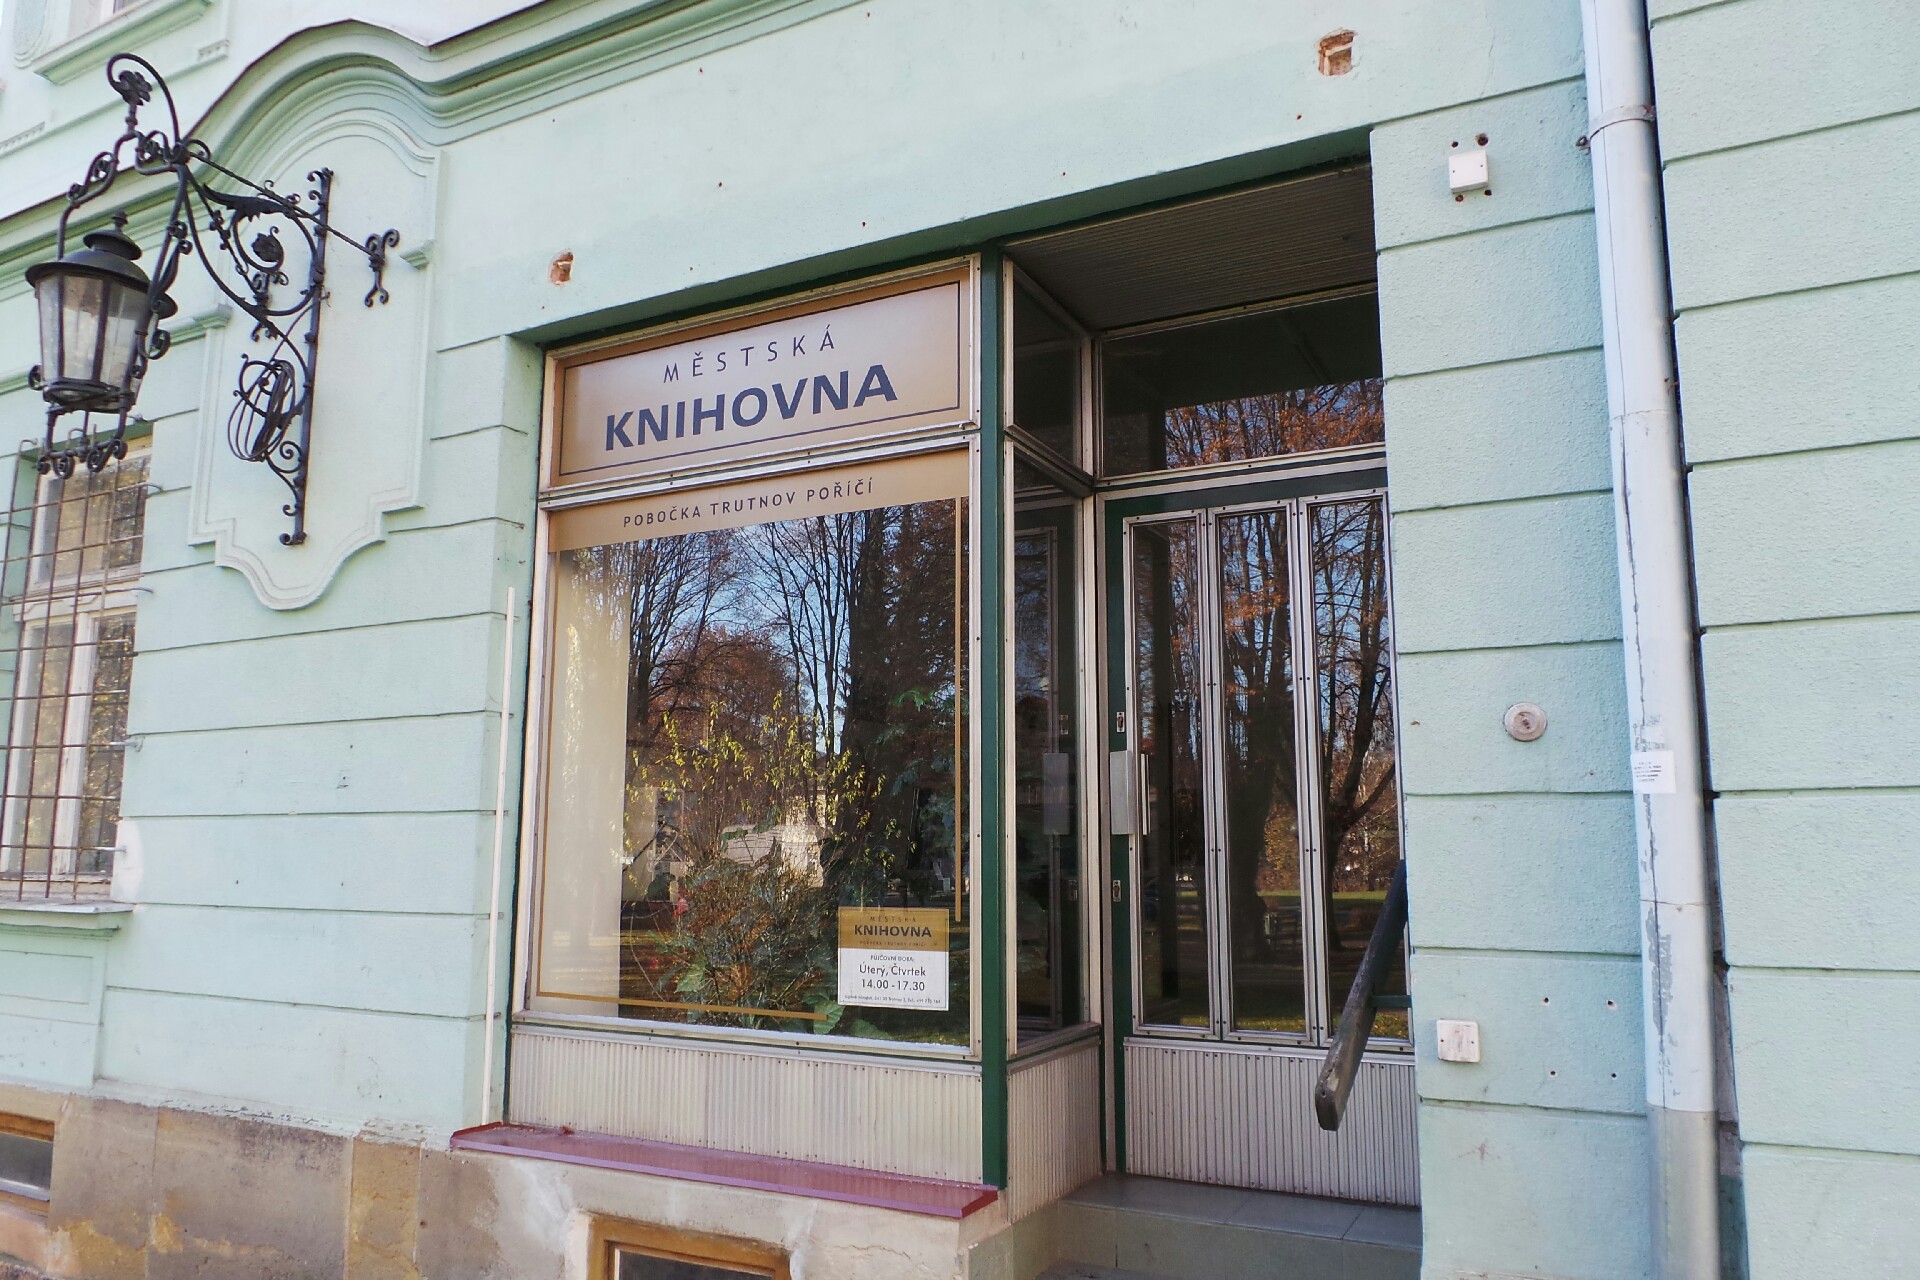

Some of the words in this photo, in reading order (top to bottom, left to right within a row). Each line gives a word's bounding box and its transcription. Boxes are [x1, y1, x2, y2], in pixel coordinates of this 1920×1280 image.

[663, 324, 836, 384] MĚSTSKÁ
[605, 363, 898, 452] KNIHOVNA
[623, 504, 702, 528] POBOČKA
[710, 491, 796, 517] TRUTNOV
[806, 477, 874, 502] POŘÍČÍ
[854, 925, 932, 937] KNIHOVNA
[859, 961, 889, 977] Úterý,
[890, 963, 926, 976] Čtvrtek
[862, 979, 889, 989] 14.00
[897, 981, 925, 991] 17.30
